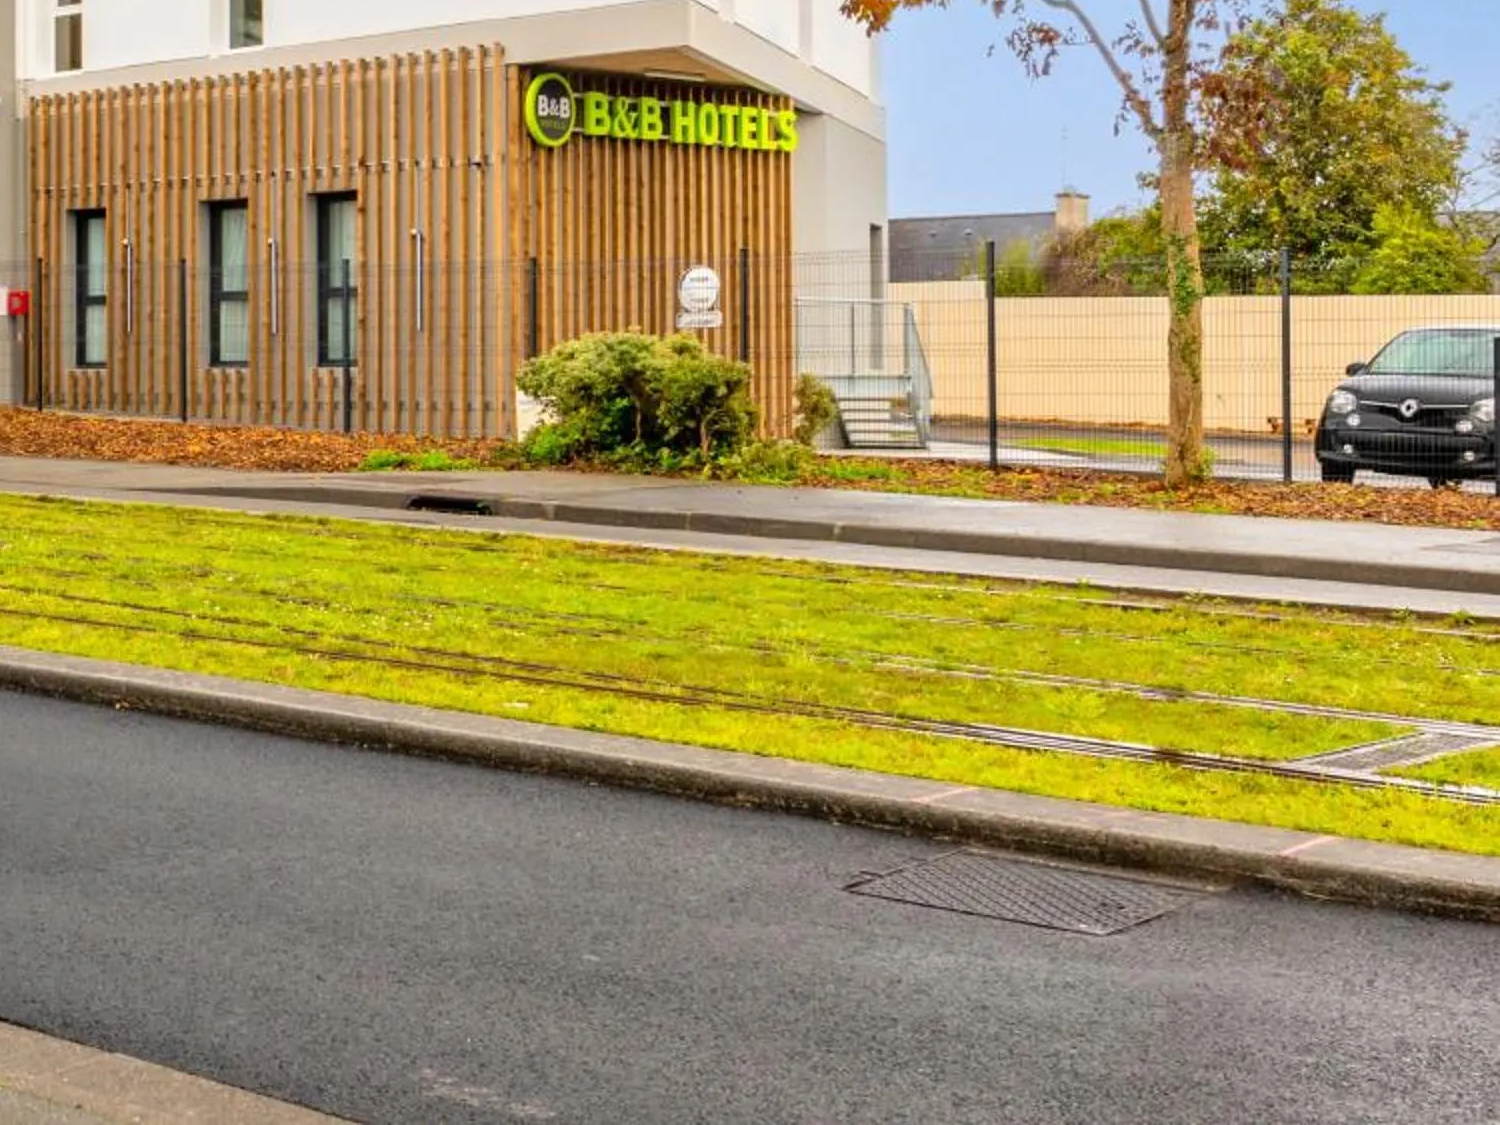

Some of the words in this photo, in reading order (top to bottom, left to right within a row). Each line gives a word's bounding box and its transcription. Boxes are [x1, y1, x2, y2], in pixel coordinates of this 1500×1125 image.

[537, 94, 571, 119] B&B
[583, 90, 663, 141] B&B
[670, 99, 799, 152] HOTELS
